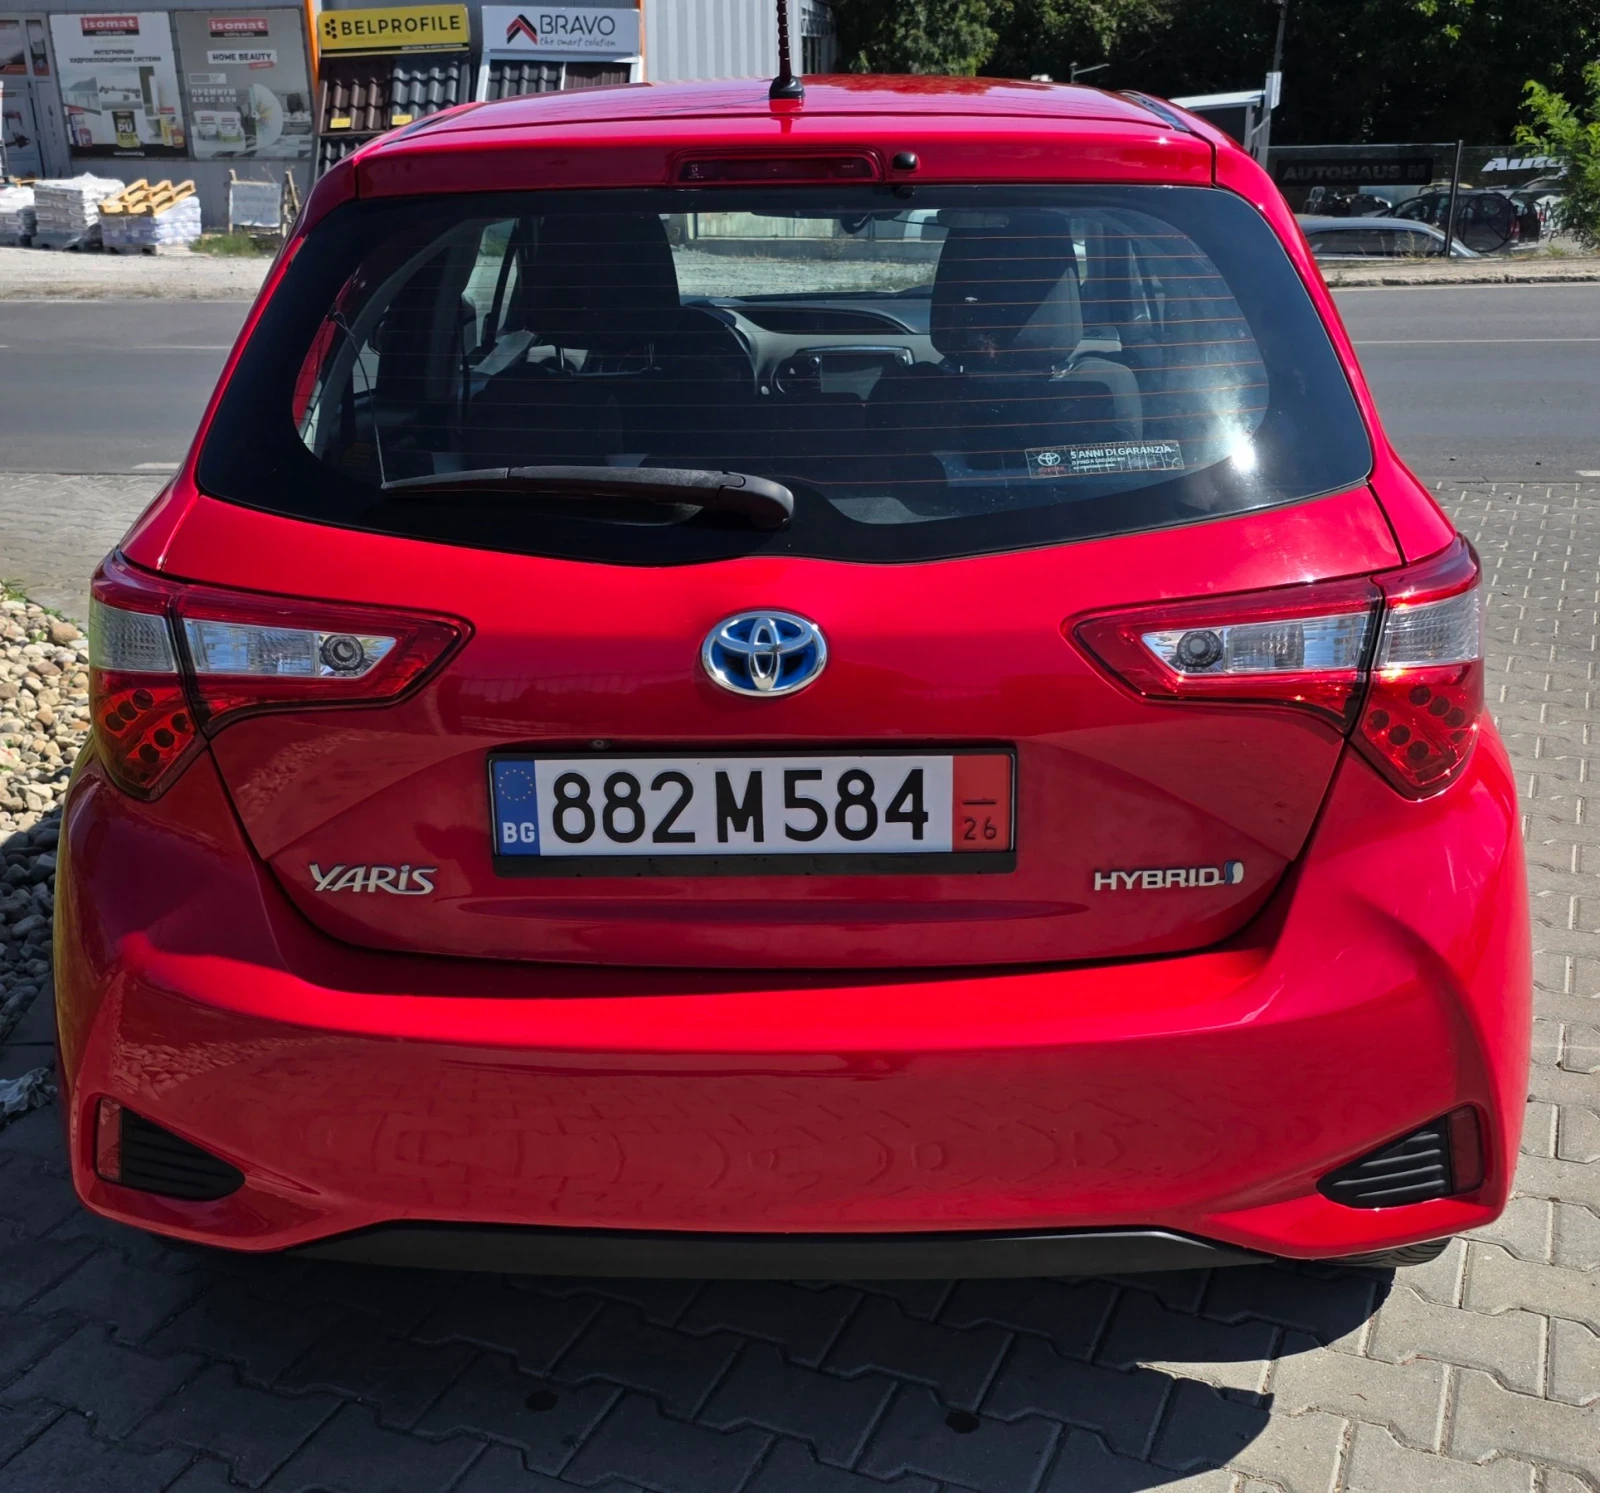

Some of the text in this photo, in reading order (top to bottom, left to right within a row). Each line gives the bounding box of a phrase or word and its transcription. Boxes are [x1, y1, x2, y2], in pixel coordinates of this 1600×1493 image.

[84, 18, 136, 28] isomat
[211, 20, 265, 30] isomat
[341, 15, 461, 36] BELPROFILE
[540, 14, 616, 36] BRAVO
[540, 36, 554, 46] the
[212, 53, 272, 61] HOME BEAUTY
[117, 123, 133, 133] PU
[1282, 165, 1399, 181] AUTOHAUS
[1070, 445, 1172, 459] 5 ANNI DI GARANZIA
[551, 766, 930, 845] 882 M 584
[502, 821, 536, 844] BG
[962, 815, 998, 841] 26
[1094, 866, 1220, 891] HYBRID
